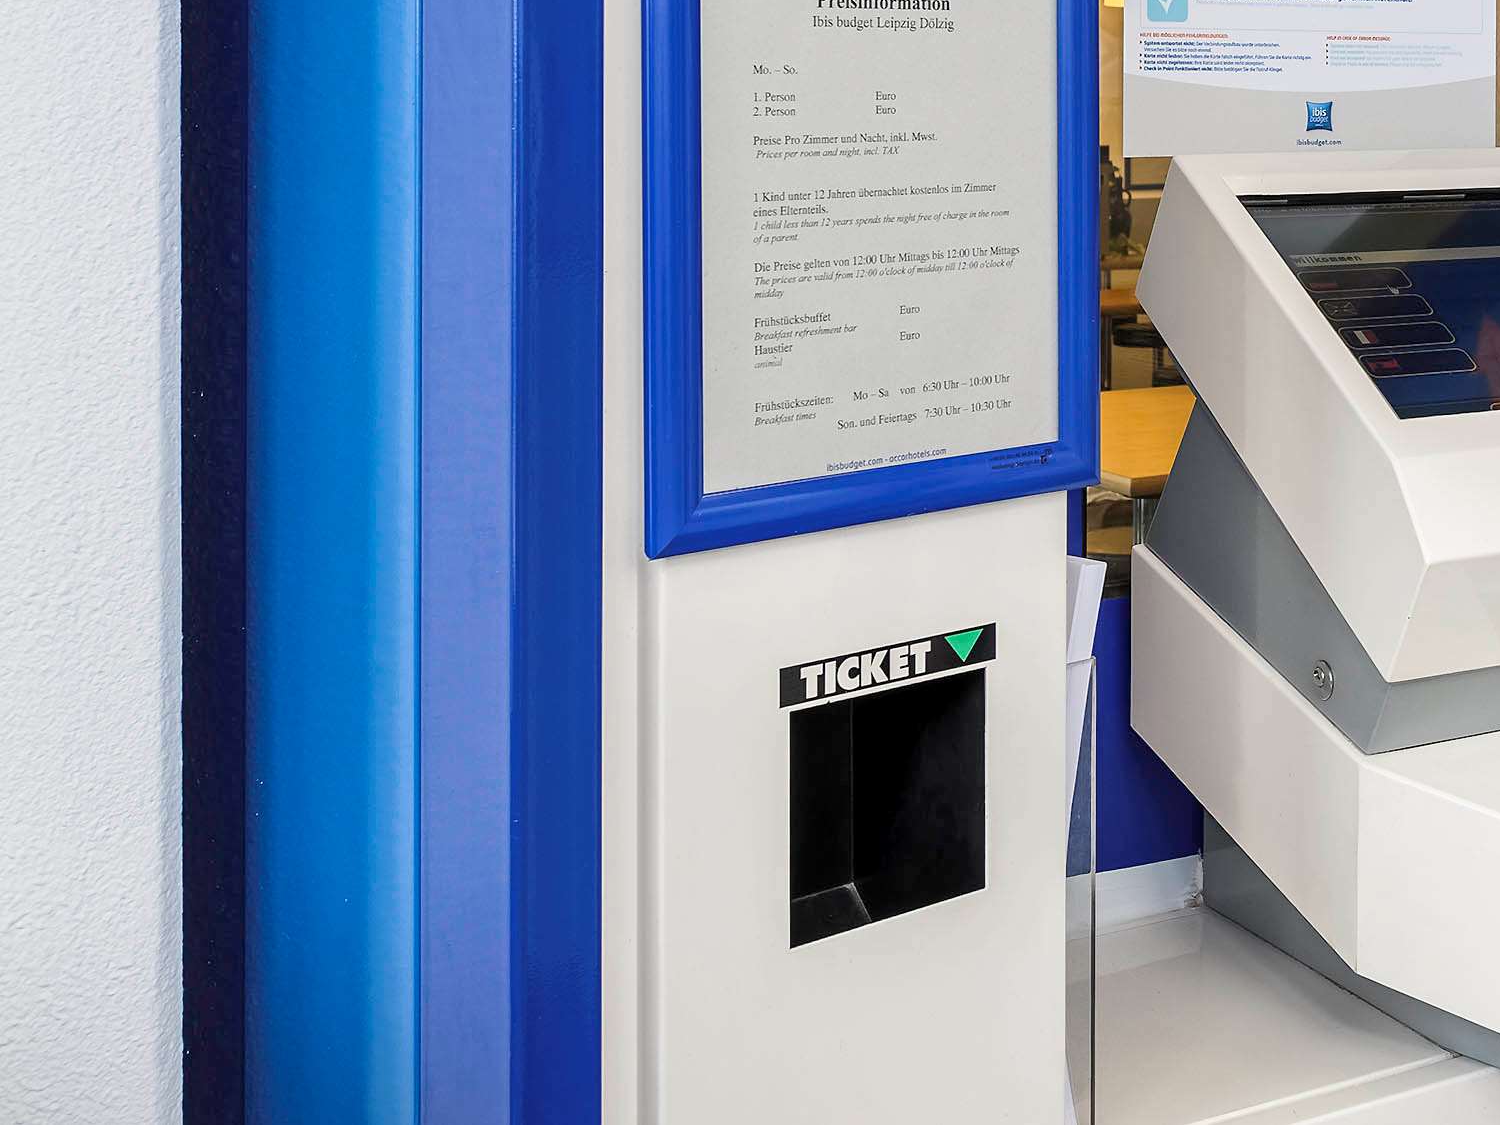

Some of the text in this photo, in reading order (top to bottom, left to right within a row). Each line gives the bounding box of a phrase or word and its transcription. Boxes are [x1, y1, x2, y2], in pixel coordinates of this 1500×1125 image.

[812, 15, 954, 32] Ibis budget Leipzig Dölzig
[752, 64, 798, 75] Mo. So.
[753, 91, 796, 102] 1. Person
[875, 90, 896, 100] Euro
[752, 106, 795, 116] 2. Person
[875, 104, 896, 115] Euro
[1311, 107, 1327, 117] ibis
[752, 130, 937, 146] Preise Pro Zimmer und Nacht, inkl. Mwst.
[753, 183, 996, 203] 1 Kind unter 12 Jahren übernachtet kostenlos im Zimmer
[752, 203, 829, 217] eines Elternteils.
[754, 245, 1020, 274] Die Preise gelten von 12:00 Uhr Mittags bis 12:00 Uhr Mittags
[899, 304, 920, 315] Euro
[899, 330, 920, 341] Euro
[754, 342, 793, 355] Haustier
[853, 373, 1010, 402] Mo Sa von 6:30 Uhr 10:00 Uhr
[837, 399, 1011, 431] Son. und Feiertags 7:30 Uhr 10:30 Uhr
[800, 640, 931, 699] TICKET
